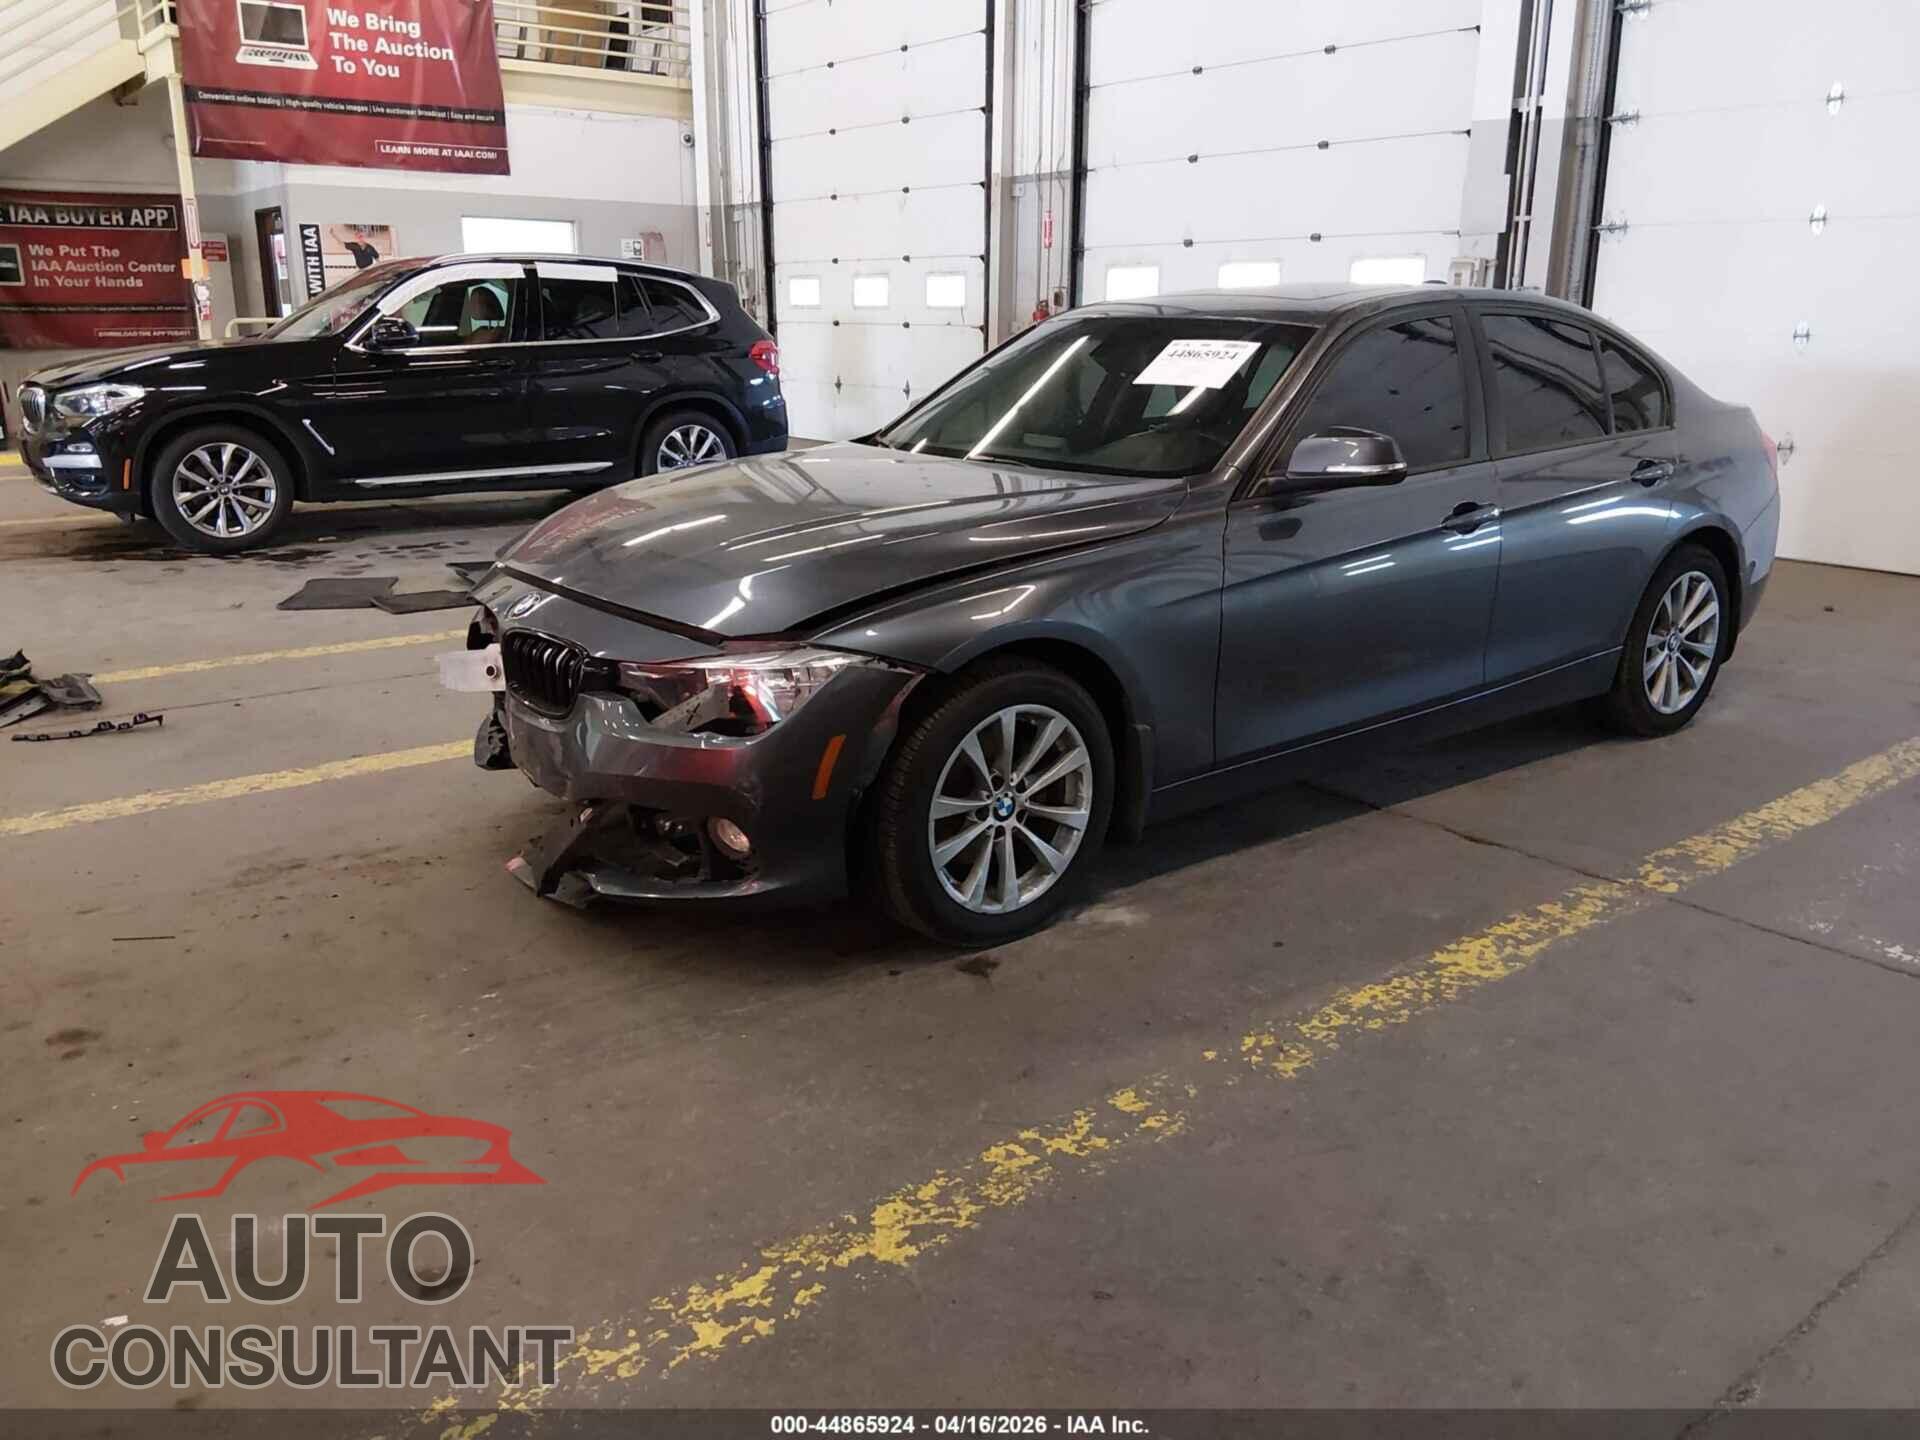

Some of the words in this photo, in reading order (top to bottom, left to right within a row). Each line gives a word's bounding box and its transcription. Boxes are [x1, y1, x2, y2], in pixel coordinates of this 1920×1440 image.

[326, 8, 359, 28] We
[365, 12, 421, 38] Bring
[329, 32, 368, 52] The
[375, 37, 454, 61] Auction
[331, 55, 356, 74] To
[363, 58, 400, 78] You
[372, 105, 384, 113] Live
[380, 145, 411, 154] LEARN
[413, 146, 439, 156] MORE
[441, 149, 452, 157] AT
[9, 205, 49, 223] IAA
[55, 206, 124, 226] BUYER
[130, 208, 168, 227] APP
[303, 227, 318, 252] IAA
[28, 244, 53, 257] We
[59, 245, 87, 257] Put
[91, 246, 120, 257] The
[31, 260, 61, 272] IAA
[65, 260, 124, 273] Auction
[128, 261, 176, 273] Center
[306, 256, 323, 294] WITH
[34, 276, 49, 288] In
[55, 276, 90, 287] Your
[95, 276, 143, 288] Hands
[1167, 349, 1239, 360] 44865924
